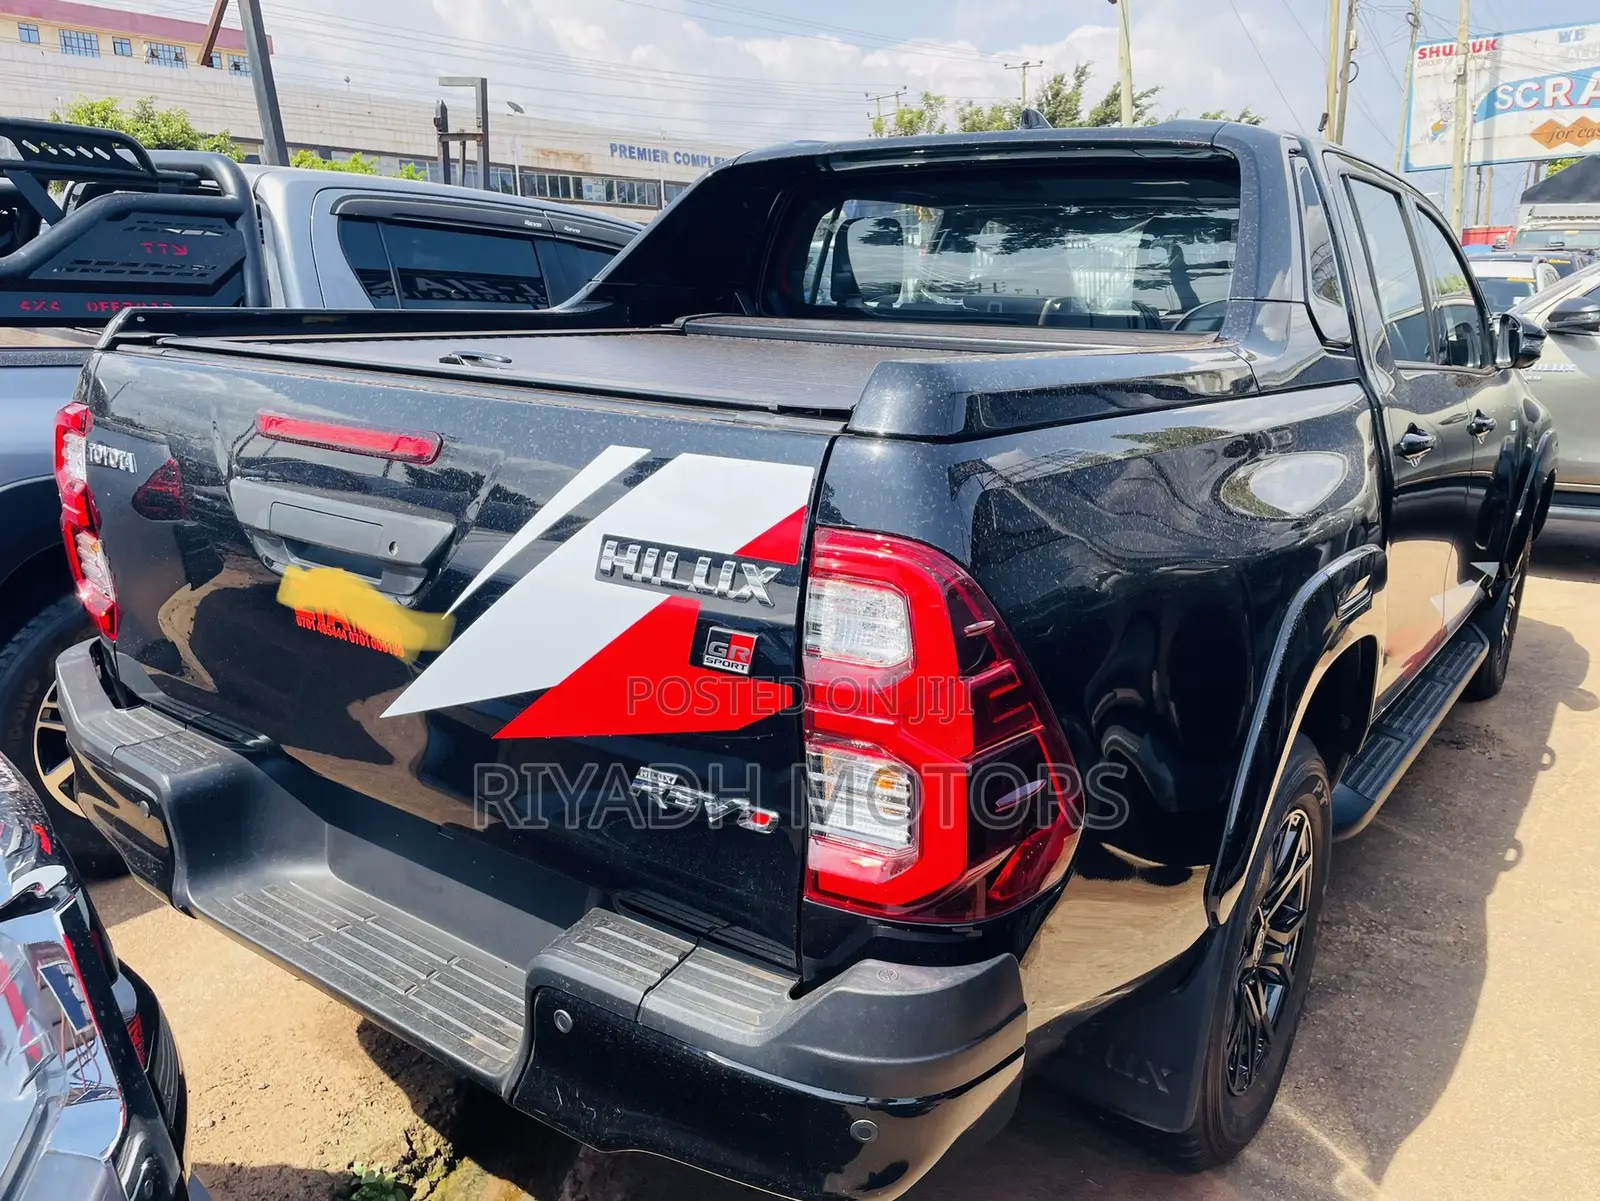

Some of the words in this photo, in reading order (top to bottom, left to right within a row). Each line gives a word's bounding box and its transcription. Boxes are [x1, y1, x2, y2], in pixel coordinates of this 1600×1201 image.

[1417, 39, 1498, 60] SHUUK
[609, 142, 670, 164] PREMIER
[673, 151, 729, 168] COMPLE
[87, 442, 138, 474] TOYOTA
[600, 540, 782, 608] HILUX
[709, 641, 751, 664] GR
[705, 656, 748, 673] SPORT
[638, 769, 675, 784] HILUX
